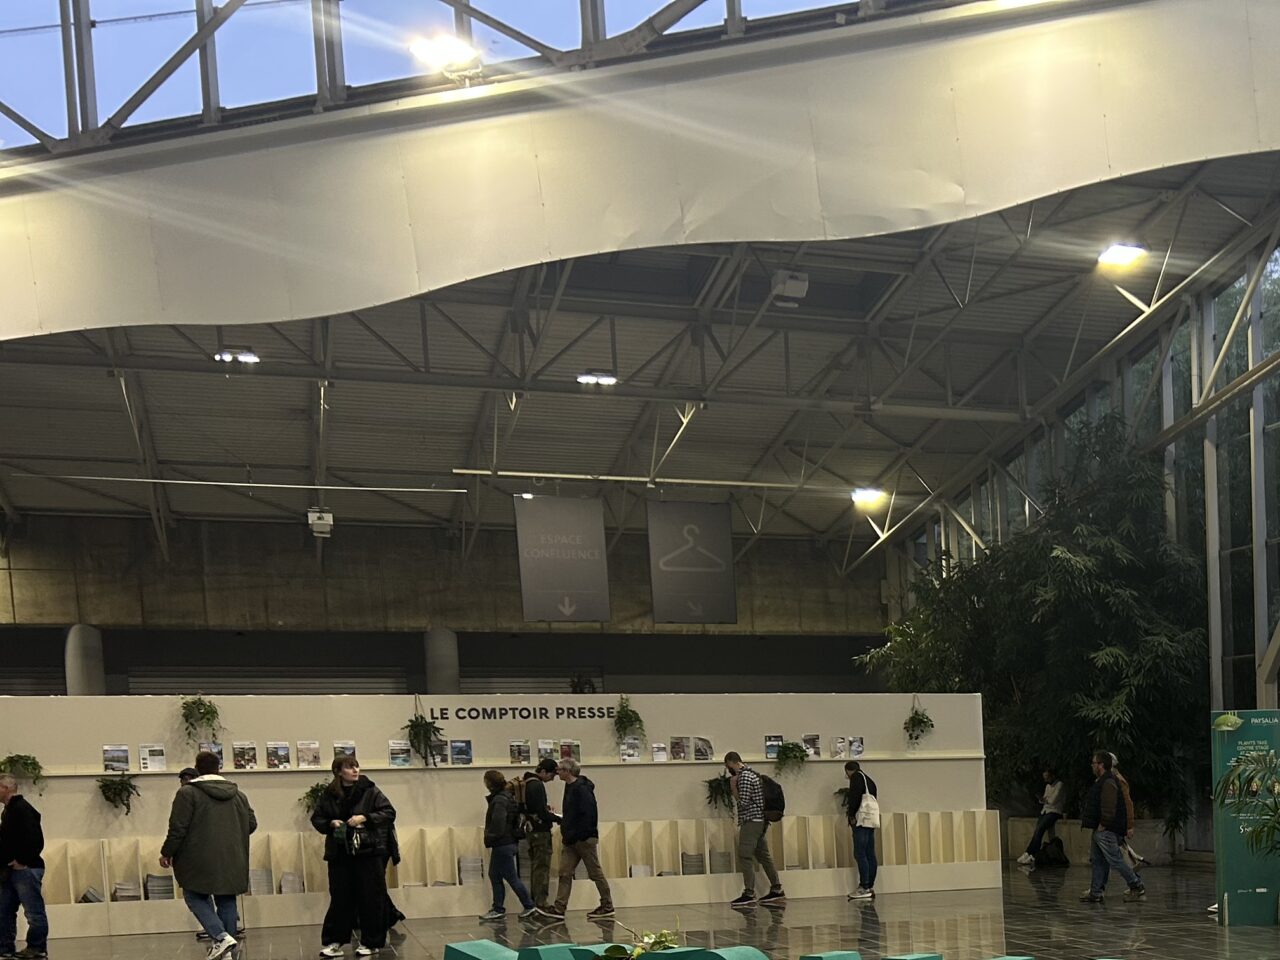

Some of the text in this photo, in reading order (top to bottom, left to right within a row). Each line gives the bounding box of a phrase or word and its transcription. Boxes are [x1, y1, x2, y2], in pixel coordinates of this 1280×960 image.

[541, 535, 583, 545] ESPACE
[523, 549, 601, 560] CONFLUENCE
[430, 706, 616, 720] LE COMPTOIR PRESSE
